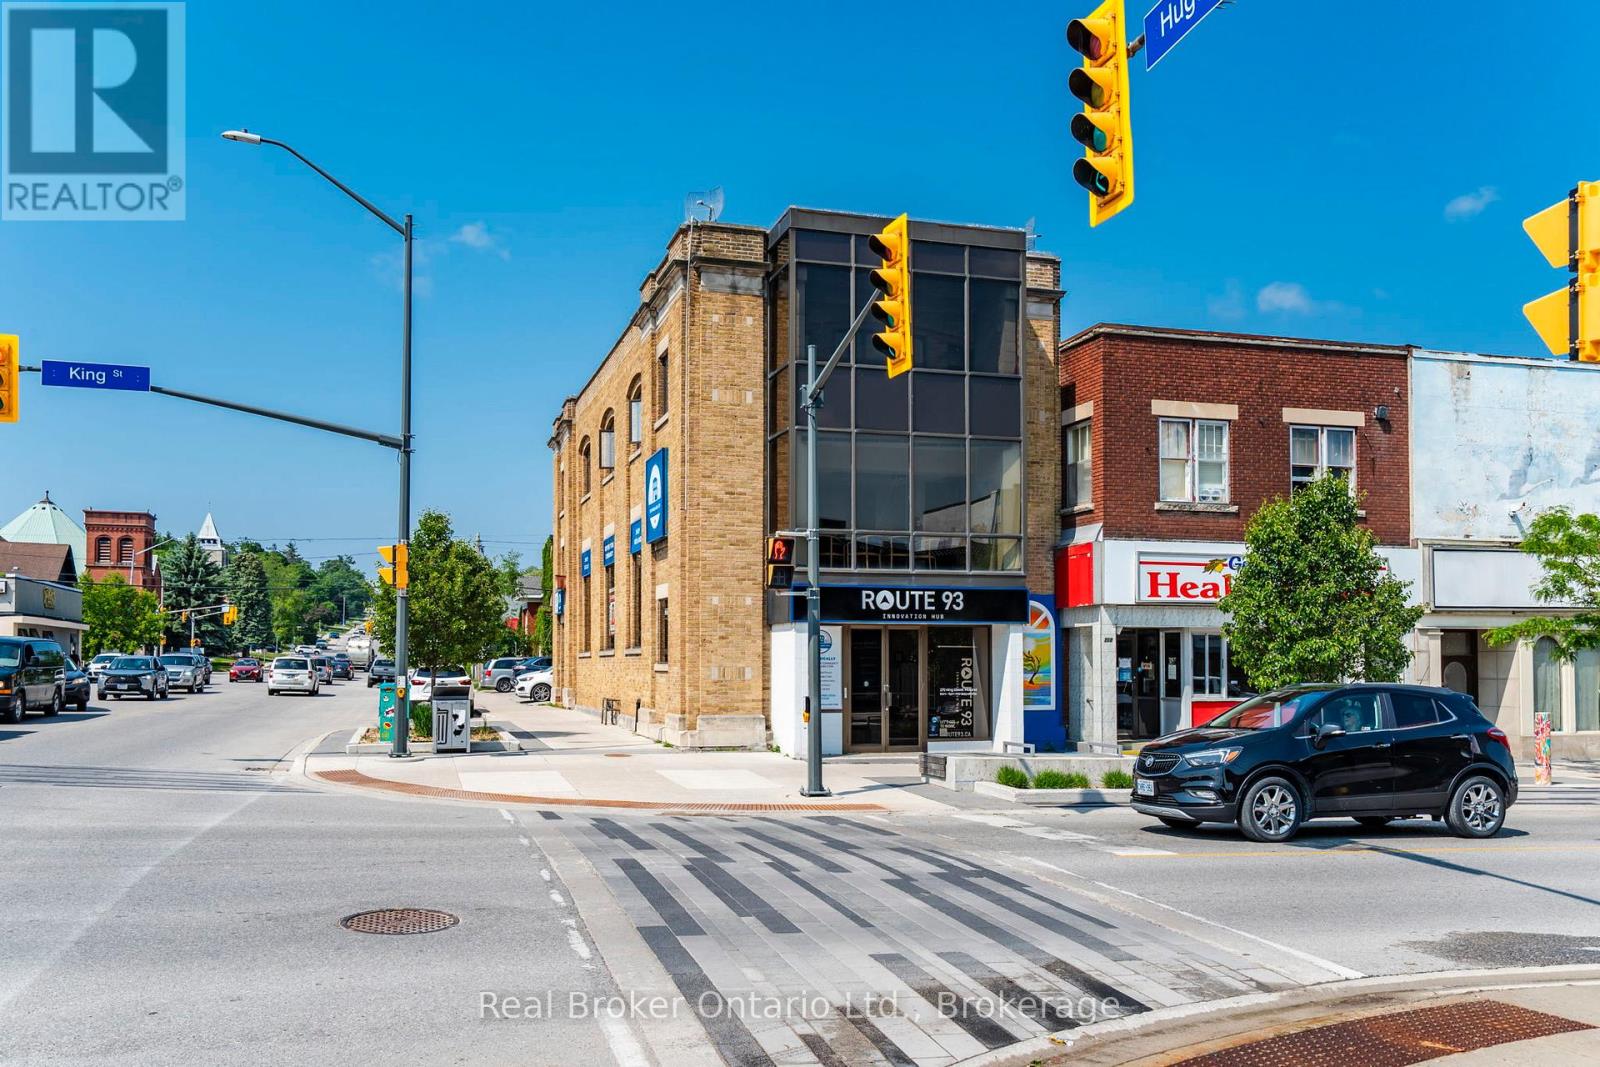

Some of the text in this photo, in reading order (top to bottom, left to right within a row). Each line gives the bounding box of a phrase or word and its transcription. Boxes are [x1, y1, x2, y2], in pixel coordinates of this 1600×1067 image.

[69, 366, 124, 385] King St
[861, 590, 964, 611] ROUTE 93
[961, 710, 973, 726] 93
